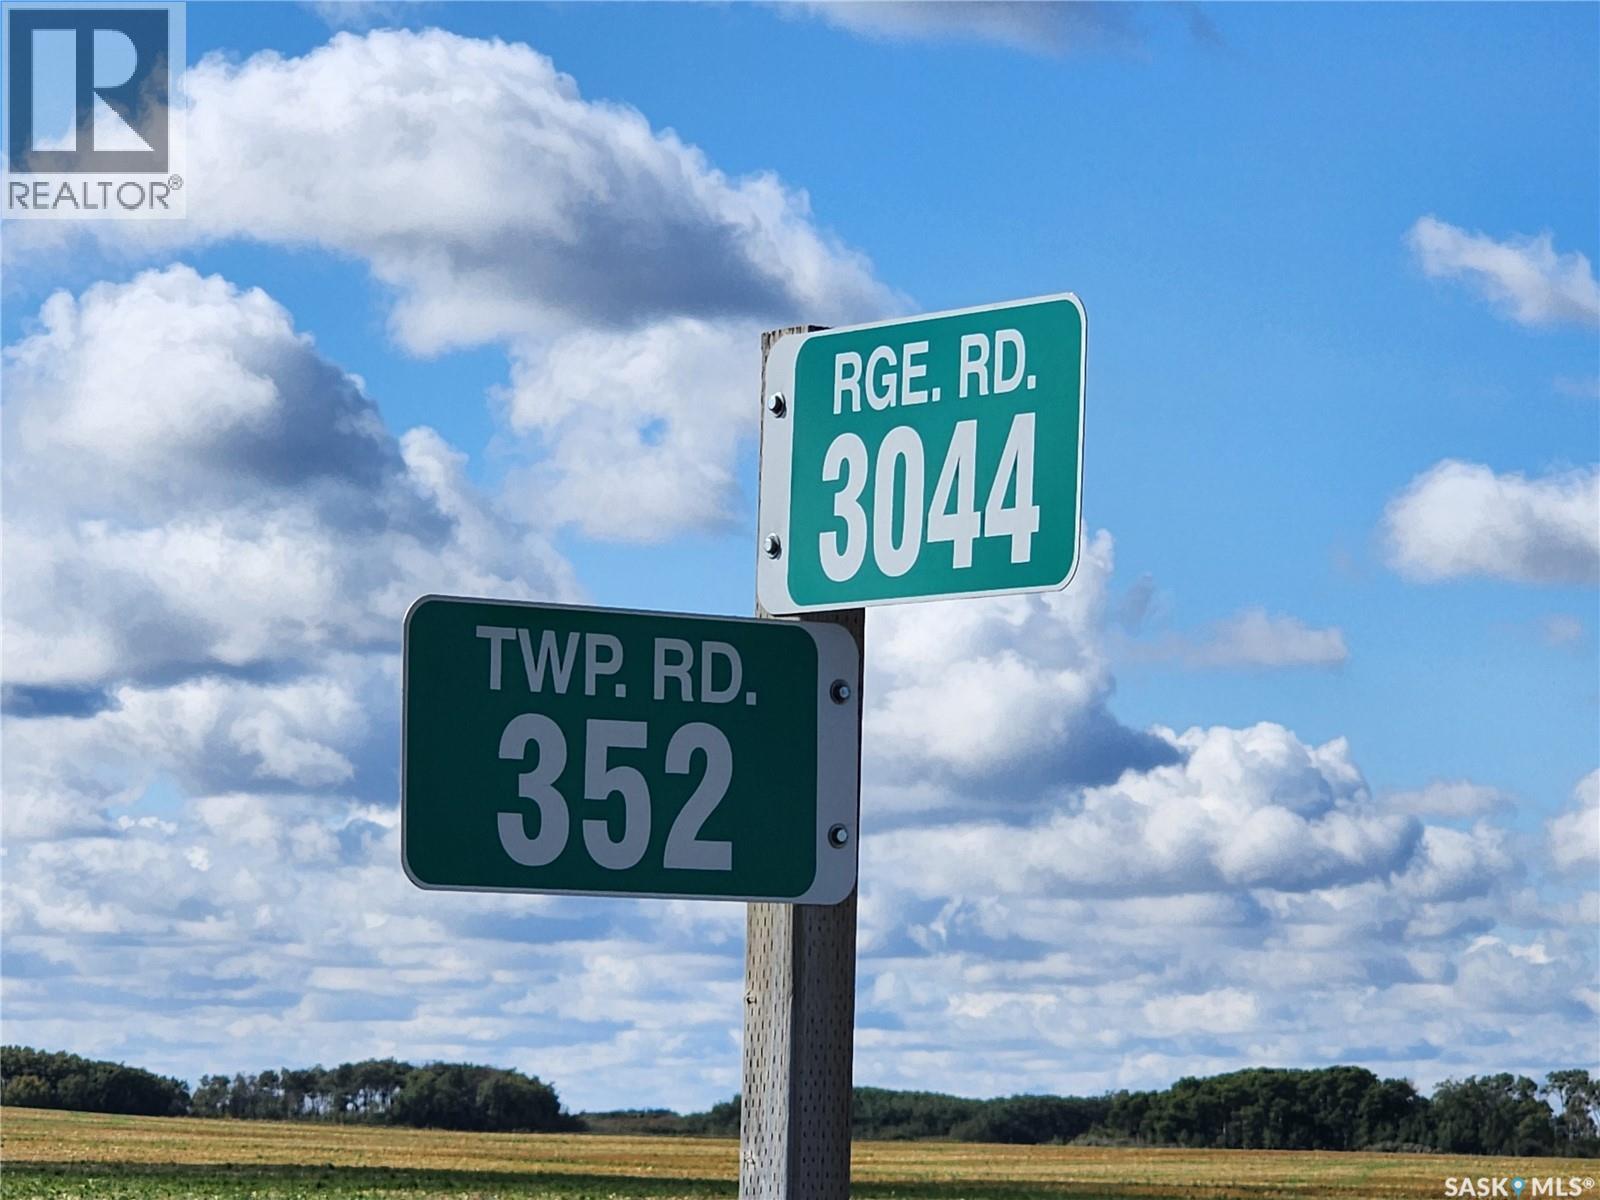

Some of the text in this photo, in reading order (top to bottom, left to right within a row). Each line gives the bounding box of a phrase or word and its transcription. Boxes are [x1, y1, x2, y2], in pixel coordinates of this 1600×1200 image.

[833, 328, 1037, 415] RGE. RD.
[819, 412, 1040, 582] 3044
[476, 625, 757, 706] TWP. RD.
[497, 712, 733, 872] 352
